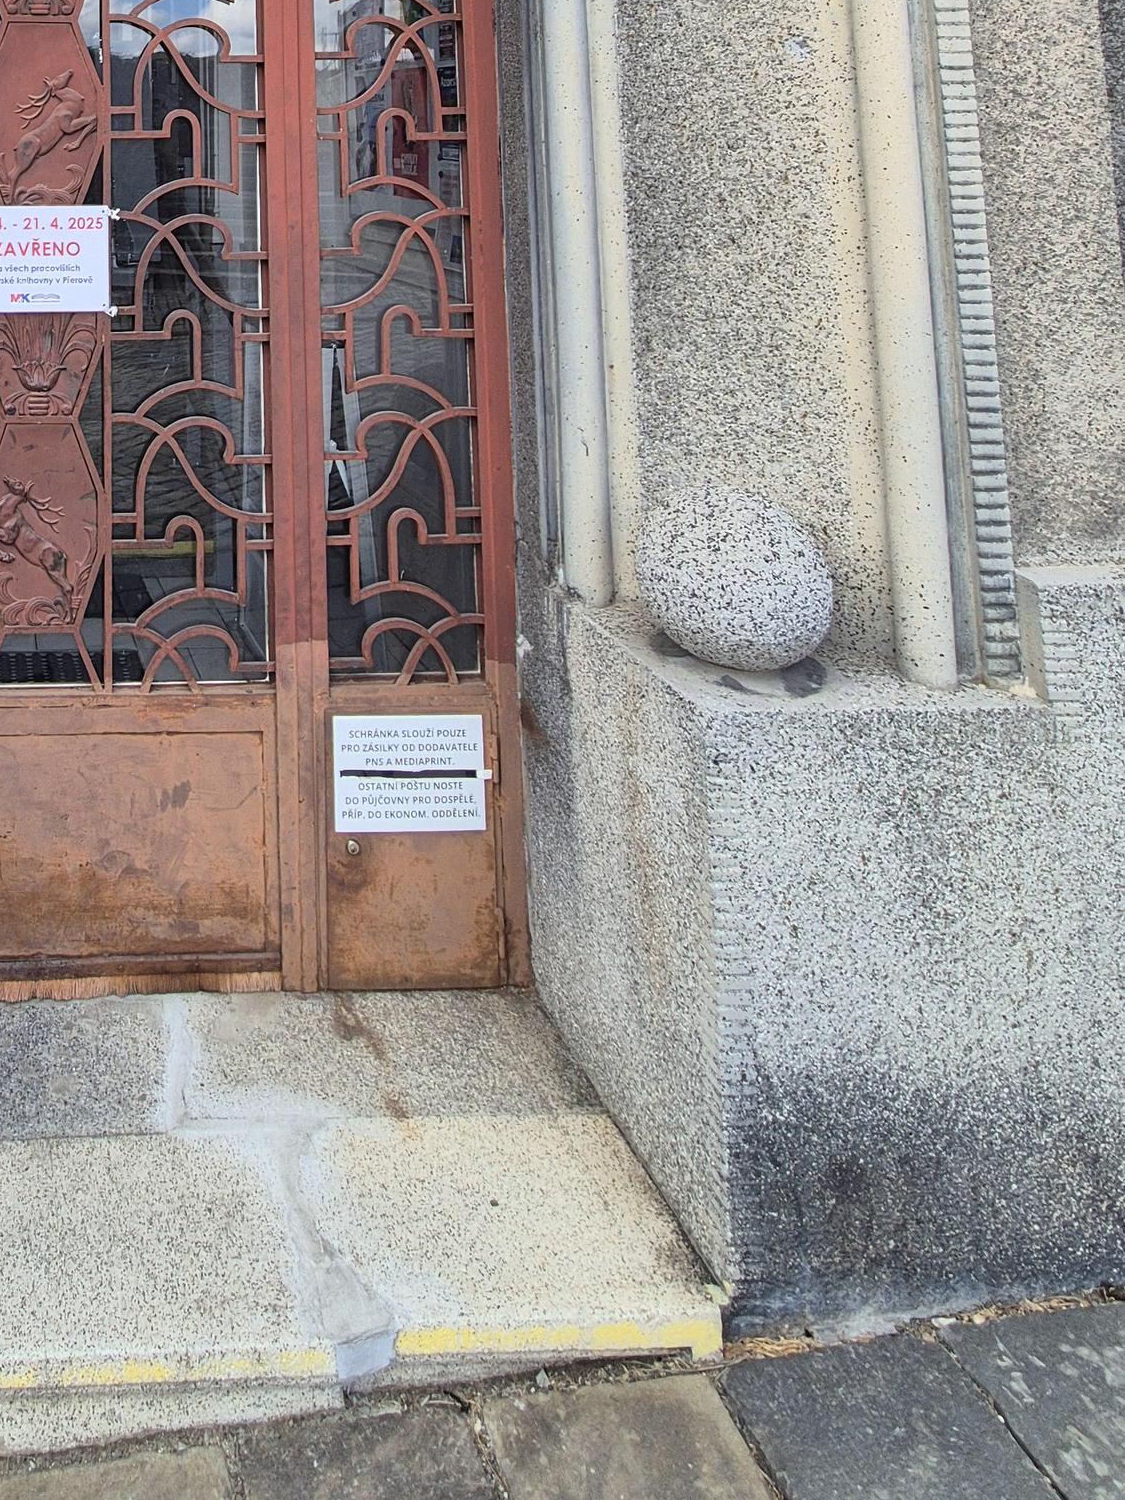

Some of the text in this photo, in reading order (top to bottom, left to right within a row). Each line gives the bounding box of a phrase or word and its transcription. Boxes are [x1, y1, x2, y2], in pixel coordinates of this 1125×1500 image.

[23, 217, 45, 230] 21.
[50, 217, 63, 230] 4.
[68, 217, 103, 230] 2025
[4, 264, 29, 273] všech
[349, 727, 467, 739] SCHRÁNKA SLOUŽÍ POUZE
[341, 741, 478, 753] PRO ZÁSILKY OD DODAVATELE
[365, 756, 456, 766] PNS A MEDIAPRINT.
[358, 780, 463, 791] OSTATNÍ POŠTU NOSTE
[345, 796, 359, 805] DO
[362, 794, 410, 807] PŮJČOVNY
[413, 796, 432, 804] PRO
[368, 810, 382, 819] DO
[385, 810, 430, 819] EKONOM.
[431, 808, 481, 818] ODDĚLENÍ.
